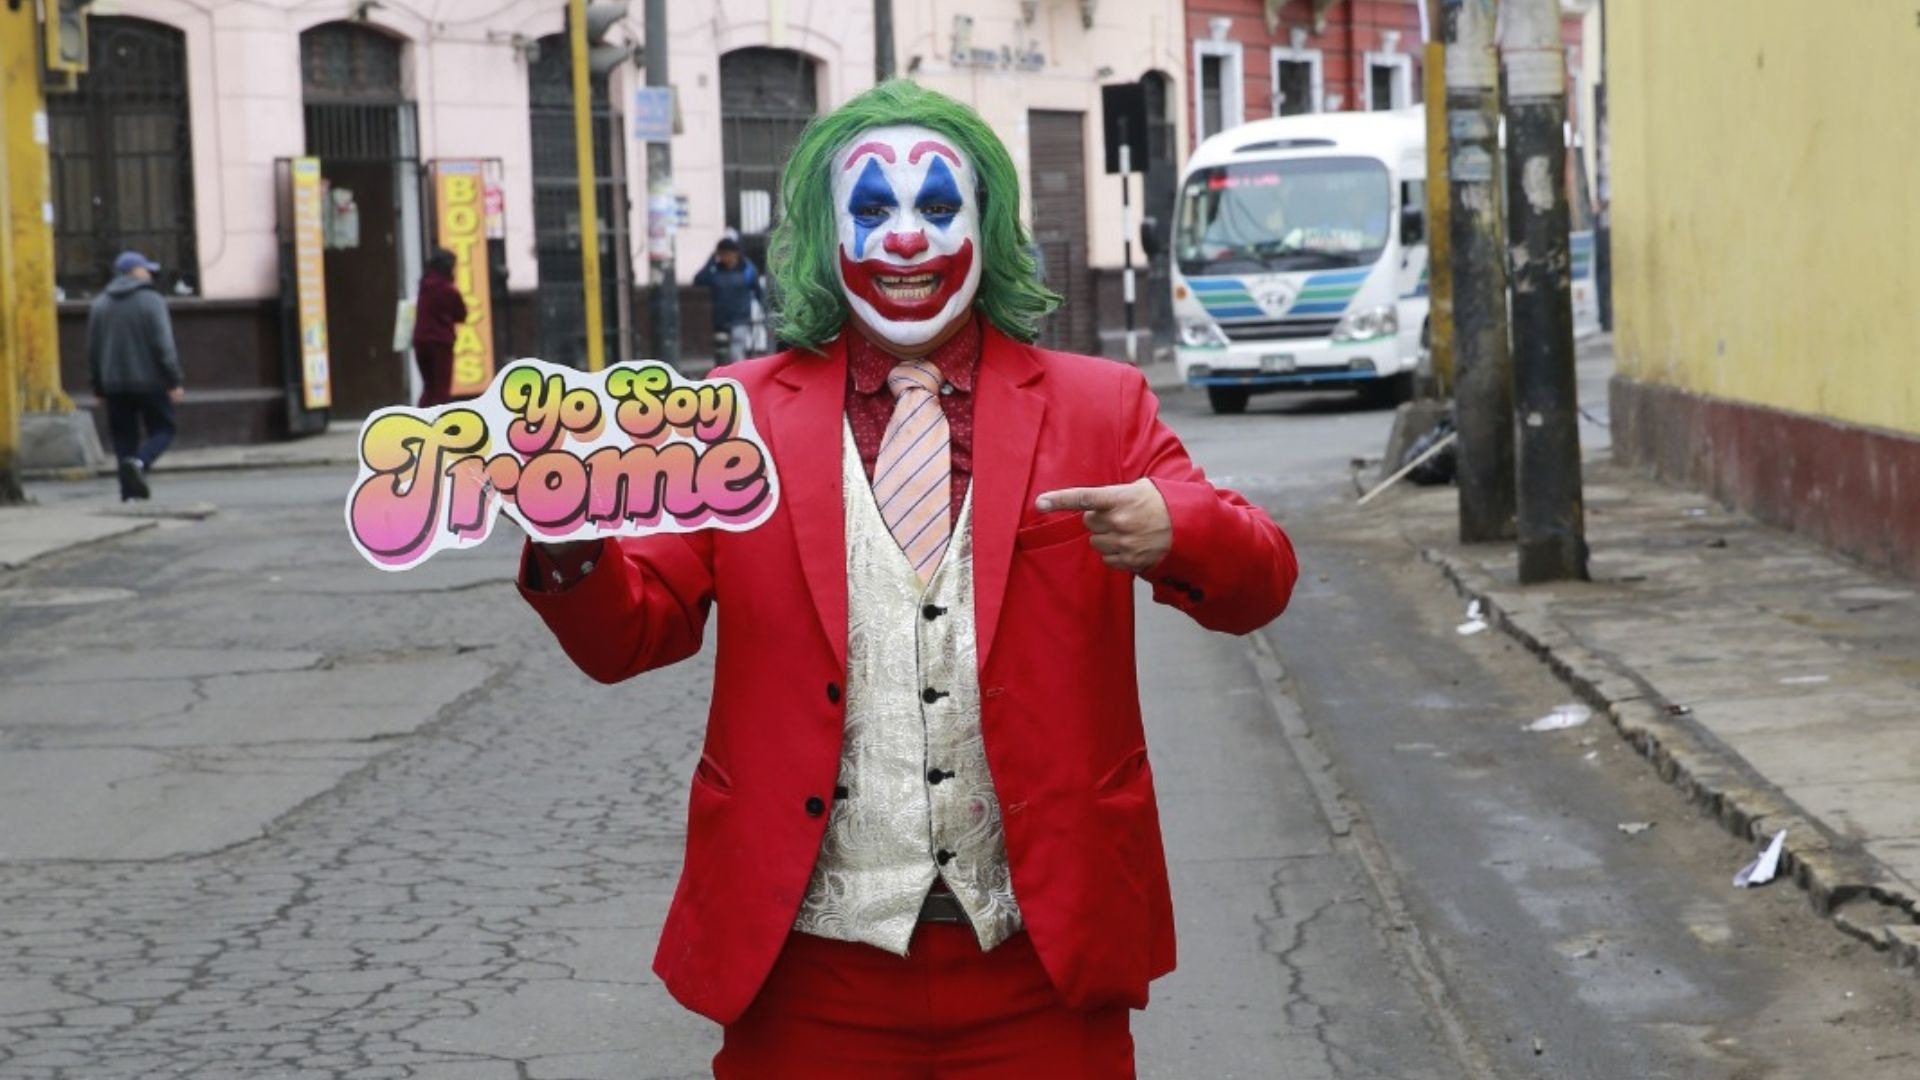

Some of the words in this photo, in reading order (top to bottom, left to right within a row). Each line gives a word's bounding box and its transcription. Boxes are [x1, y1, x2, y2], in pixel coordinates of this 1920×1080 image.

[445, 175, 485, 386] BOTICAS
[351, 408, 772, 562] Trome
[501, 366, 604, 457] Yo
[605, 366, 740, 445] Soy
